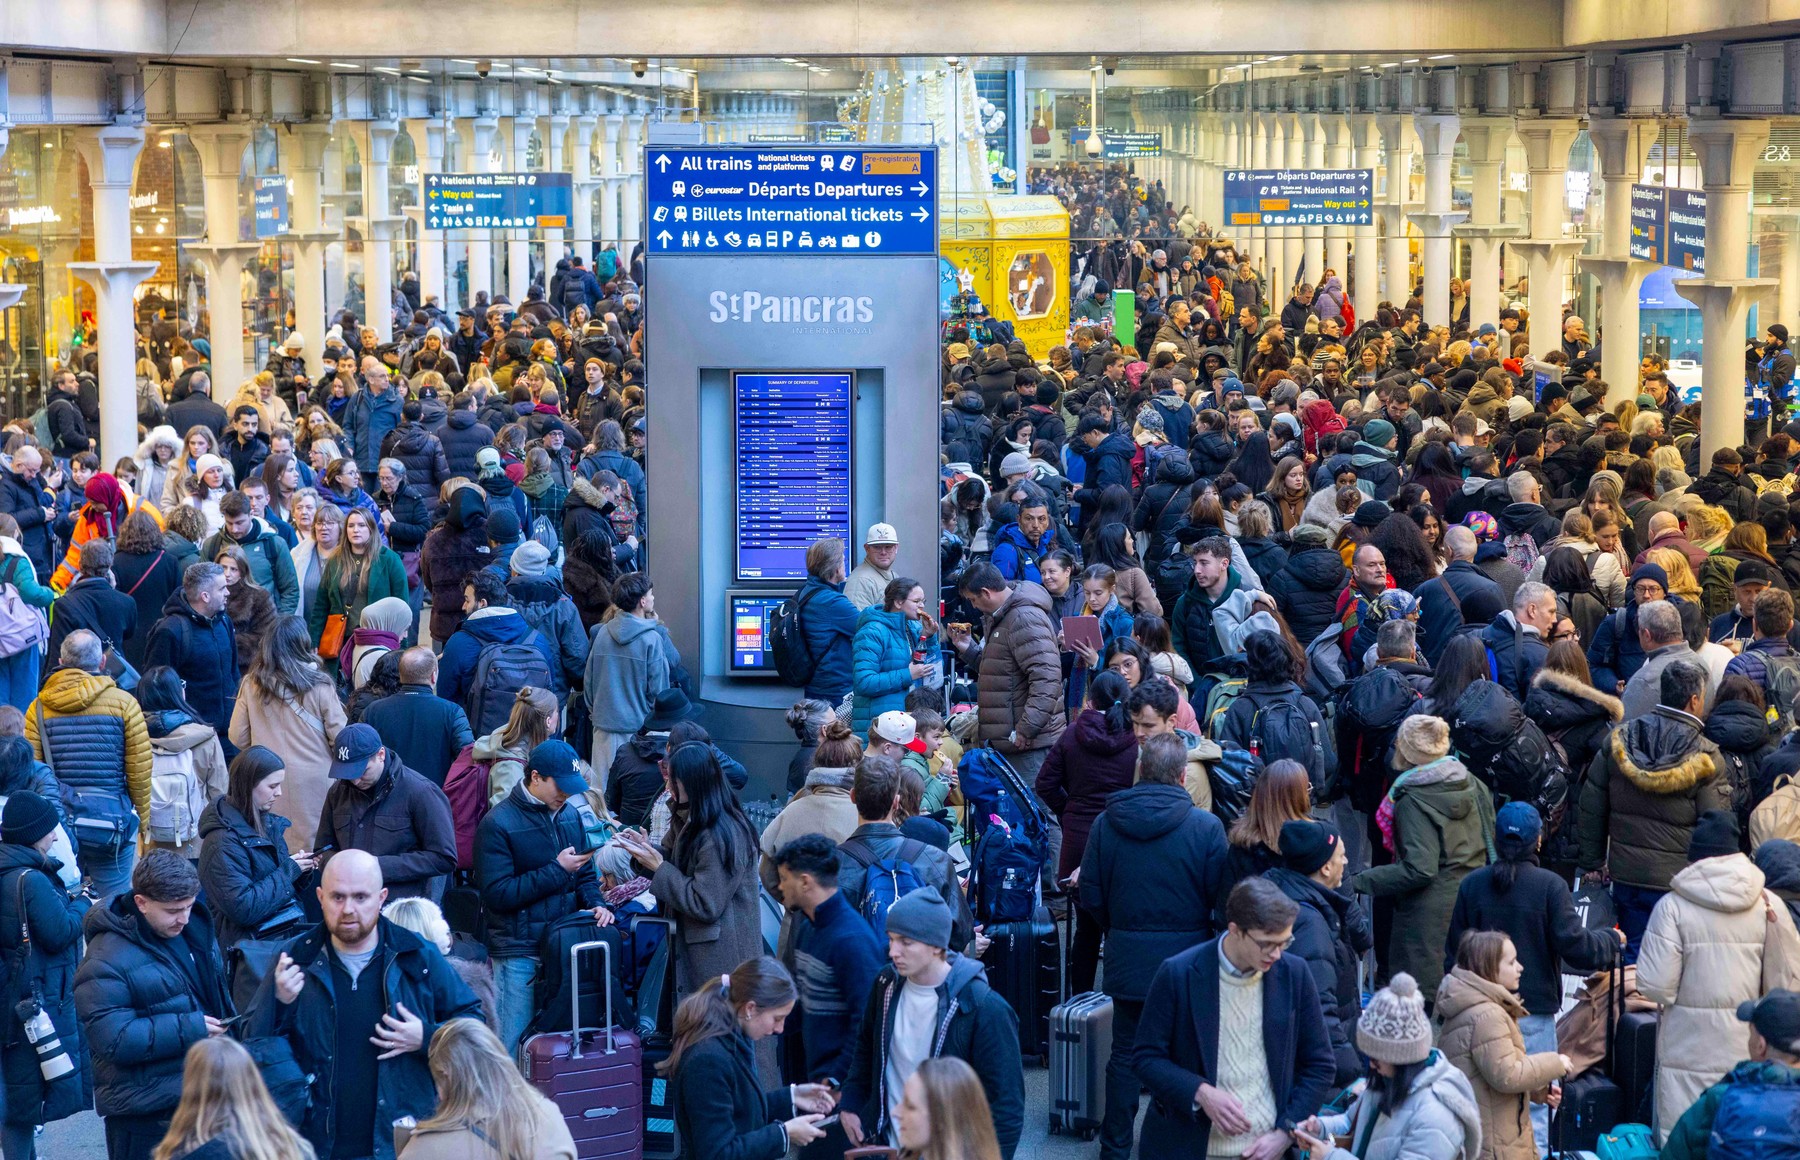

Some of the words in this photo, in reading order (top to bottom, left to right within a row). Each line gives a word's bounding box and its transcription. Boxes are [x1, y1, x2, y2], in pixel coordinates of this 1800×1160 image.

[680, 157, 702, 170] All
[706, 156, 752, 170] trains
[864, 155, 920, 163] Pre-registration
[773, 163, 809, 172] platforms
[912, 164, 919, 172] A
[442, 176, 475, 185] National
[477, 176, 492, 185] Rail
[1277, 172, 1308, 182] Départs
[1310, 172, 1355, 181] Departures
[442, 190, 459, 200] Way
[749, 181, 810, 199] Départs
[815, 182, 903, 199] Departures
[1304, 186, 1338, 195] National
[1324, 200, 1341, 210] Way
[693, 206, 742, 221] Billets
[747, 206, 847, 222] International
[851, 207, 903, 222] tickets
[744, 291, 874, 323] Pancras
